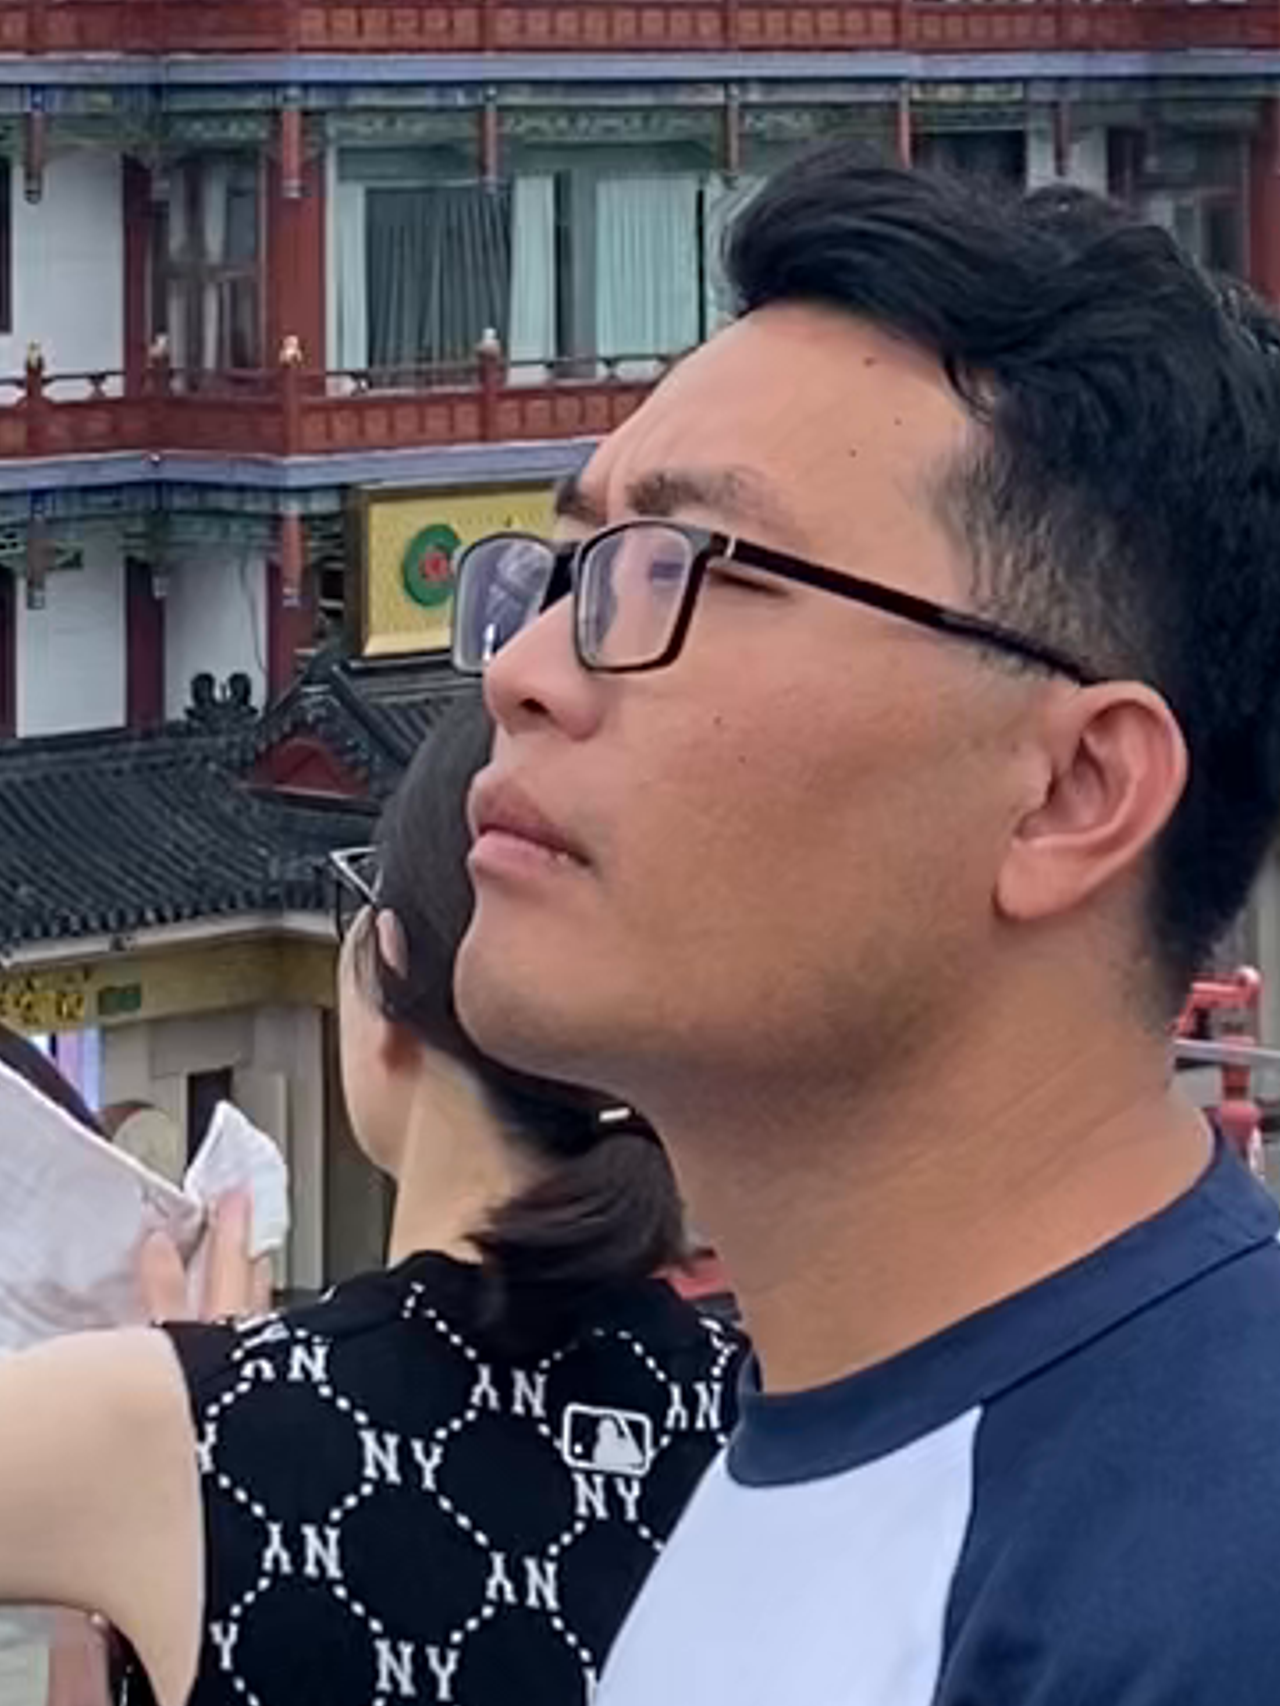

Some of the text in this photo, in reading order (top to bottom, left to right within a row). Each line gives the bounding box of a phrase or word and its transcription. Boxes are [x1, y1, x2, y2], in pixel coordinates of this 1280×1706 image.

[358, 1429, 444, 1490] NY
[572, 1473, 641, 1521] NY
[374, 1639, 461, 1701] NY
